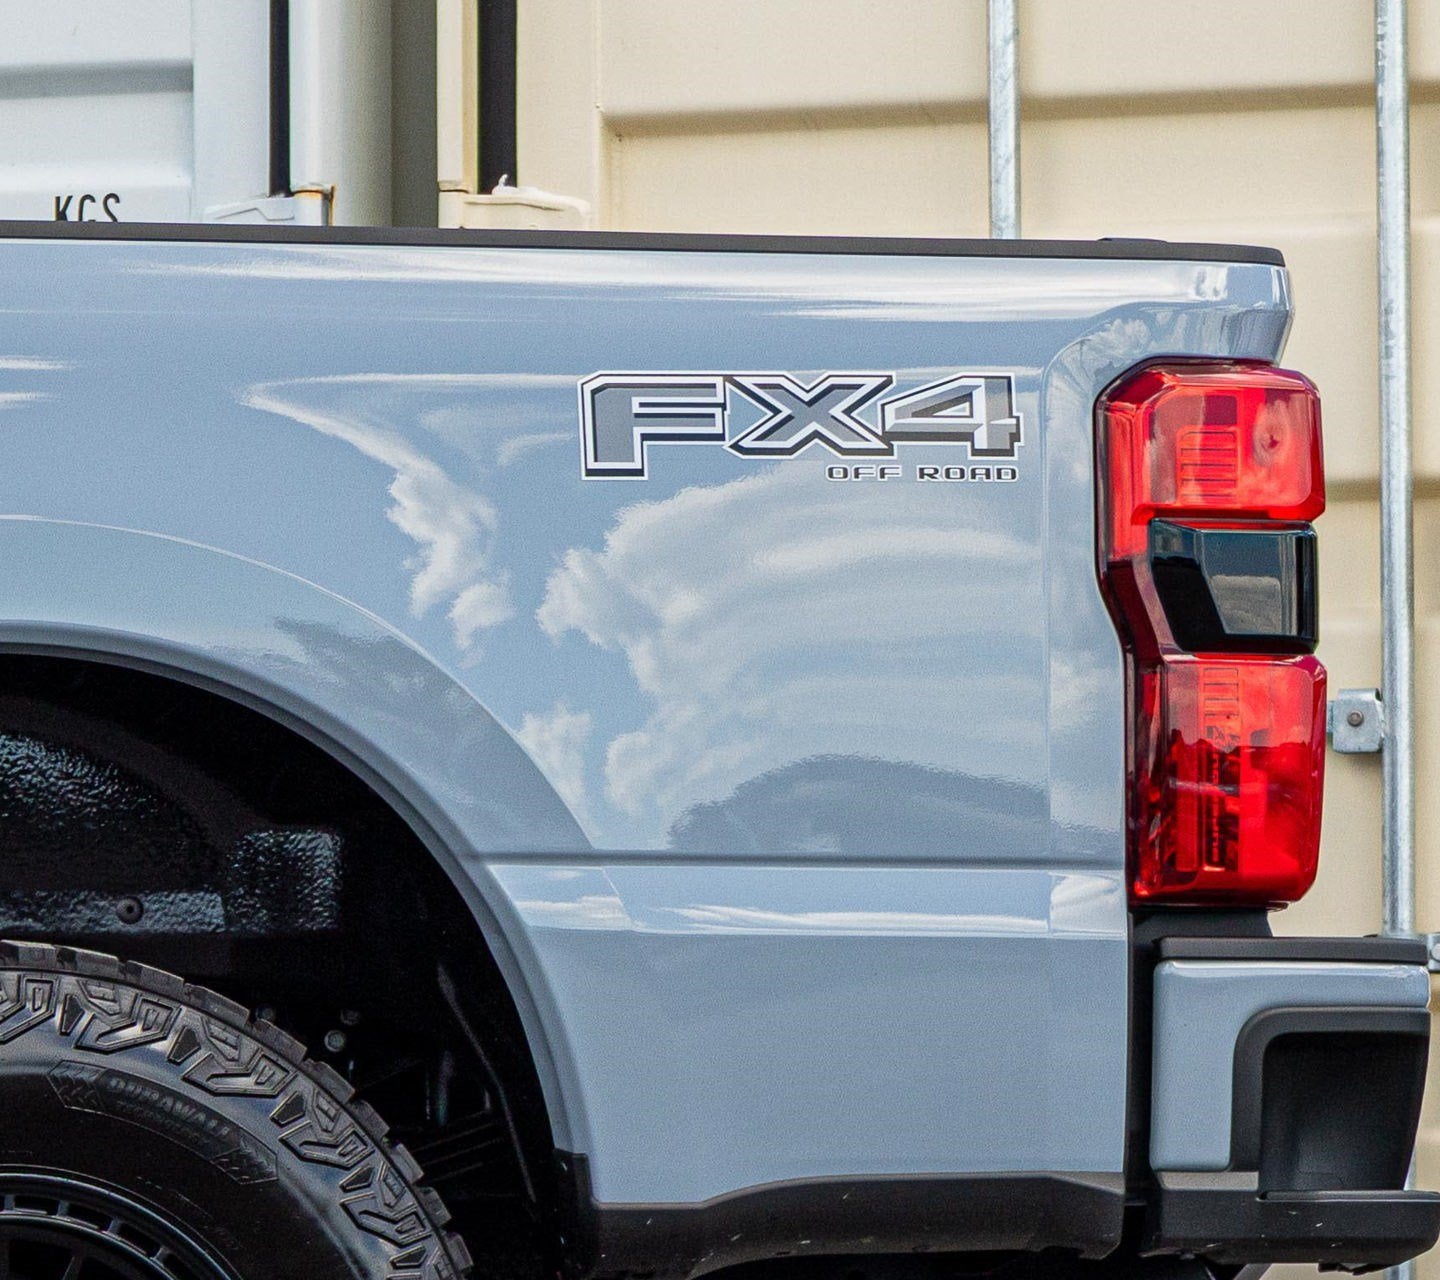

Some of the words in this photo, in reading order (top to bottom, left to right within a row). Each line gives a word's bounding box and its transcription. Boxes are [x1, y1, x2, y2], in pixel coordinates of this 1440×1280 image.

[578, 370, 1024, 481] FX4
[826, 464, 903, 483] OFF
[917, 464, 1019, 483] ROAD
